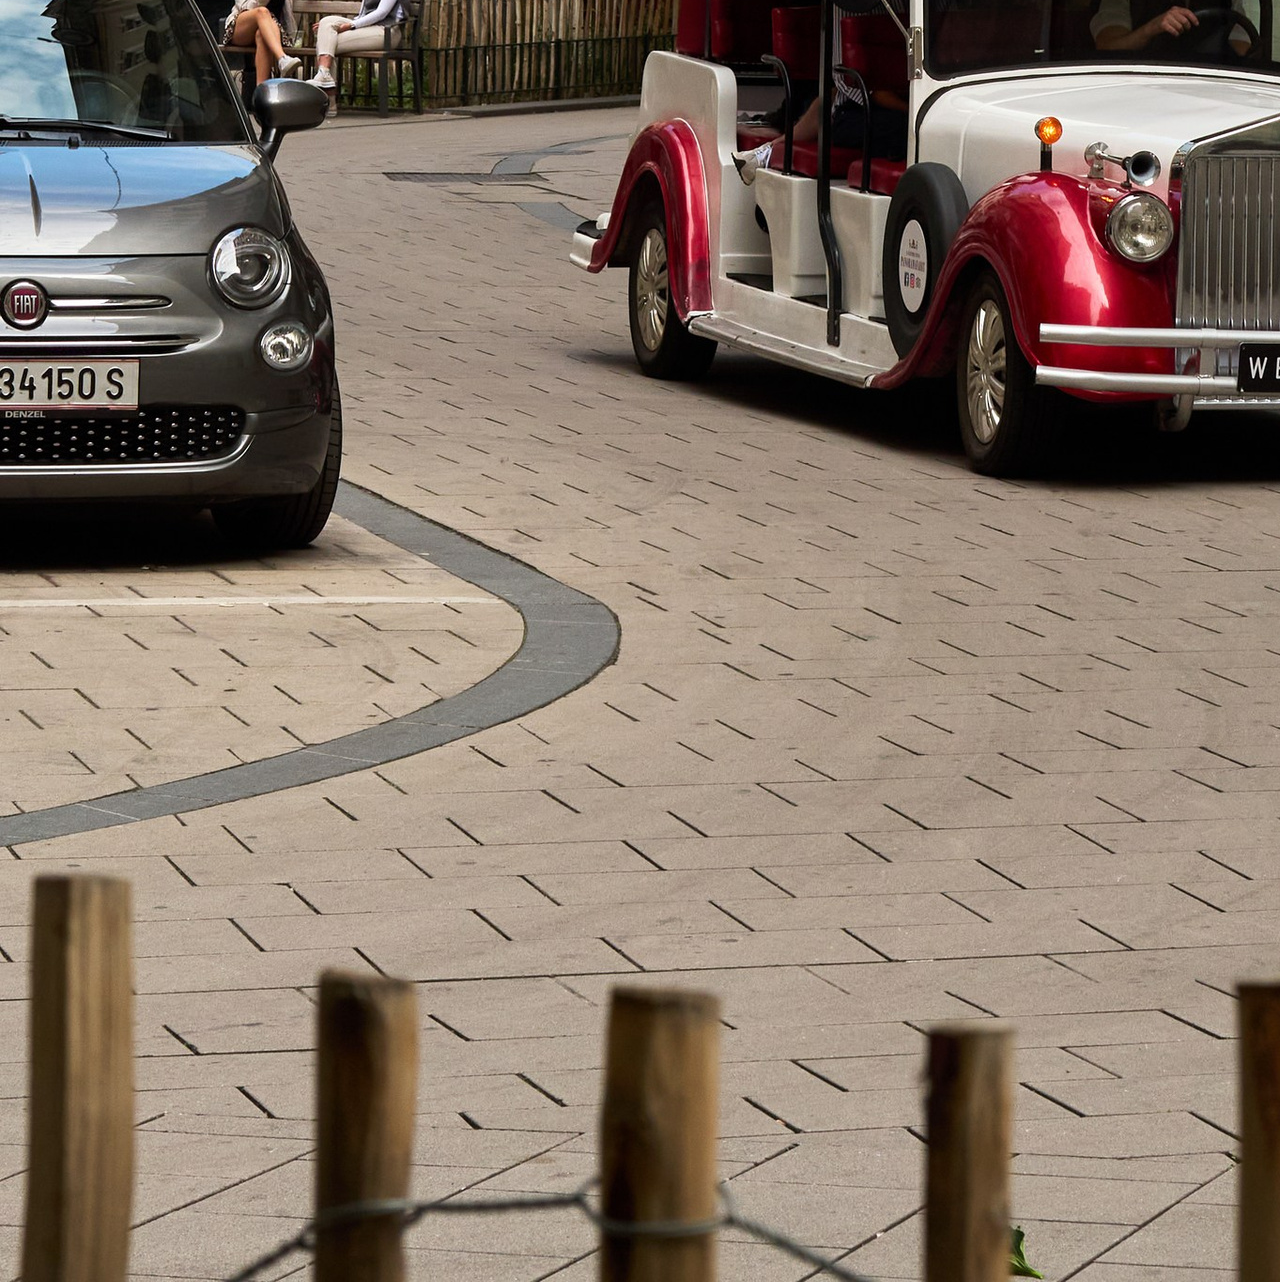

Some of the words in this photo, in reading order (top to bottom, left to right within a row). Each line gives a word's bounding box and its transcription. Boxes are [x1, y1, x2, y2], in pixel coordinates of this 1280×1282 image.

[14, 295, 37, 314] FIAT
[1249, 356, 1268, 380] W
[105, 368, 125, 401] S
[5, 410, 46, 419] DENZEL
